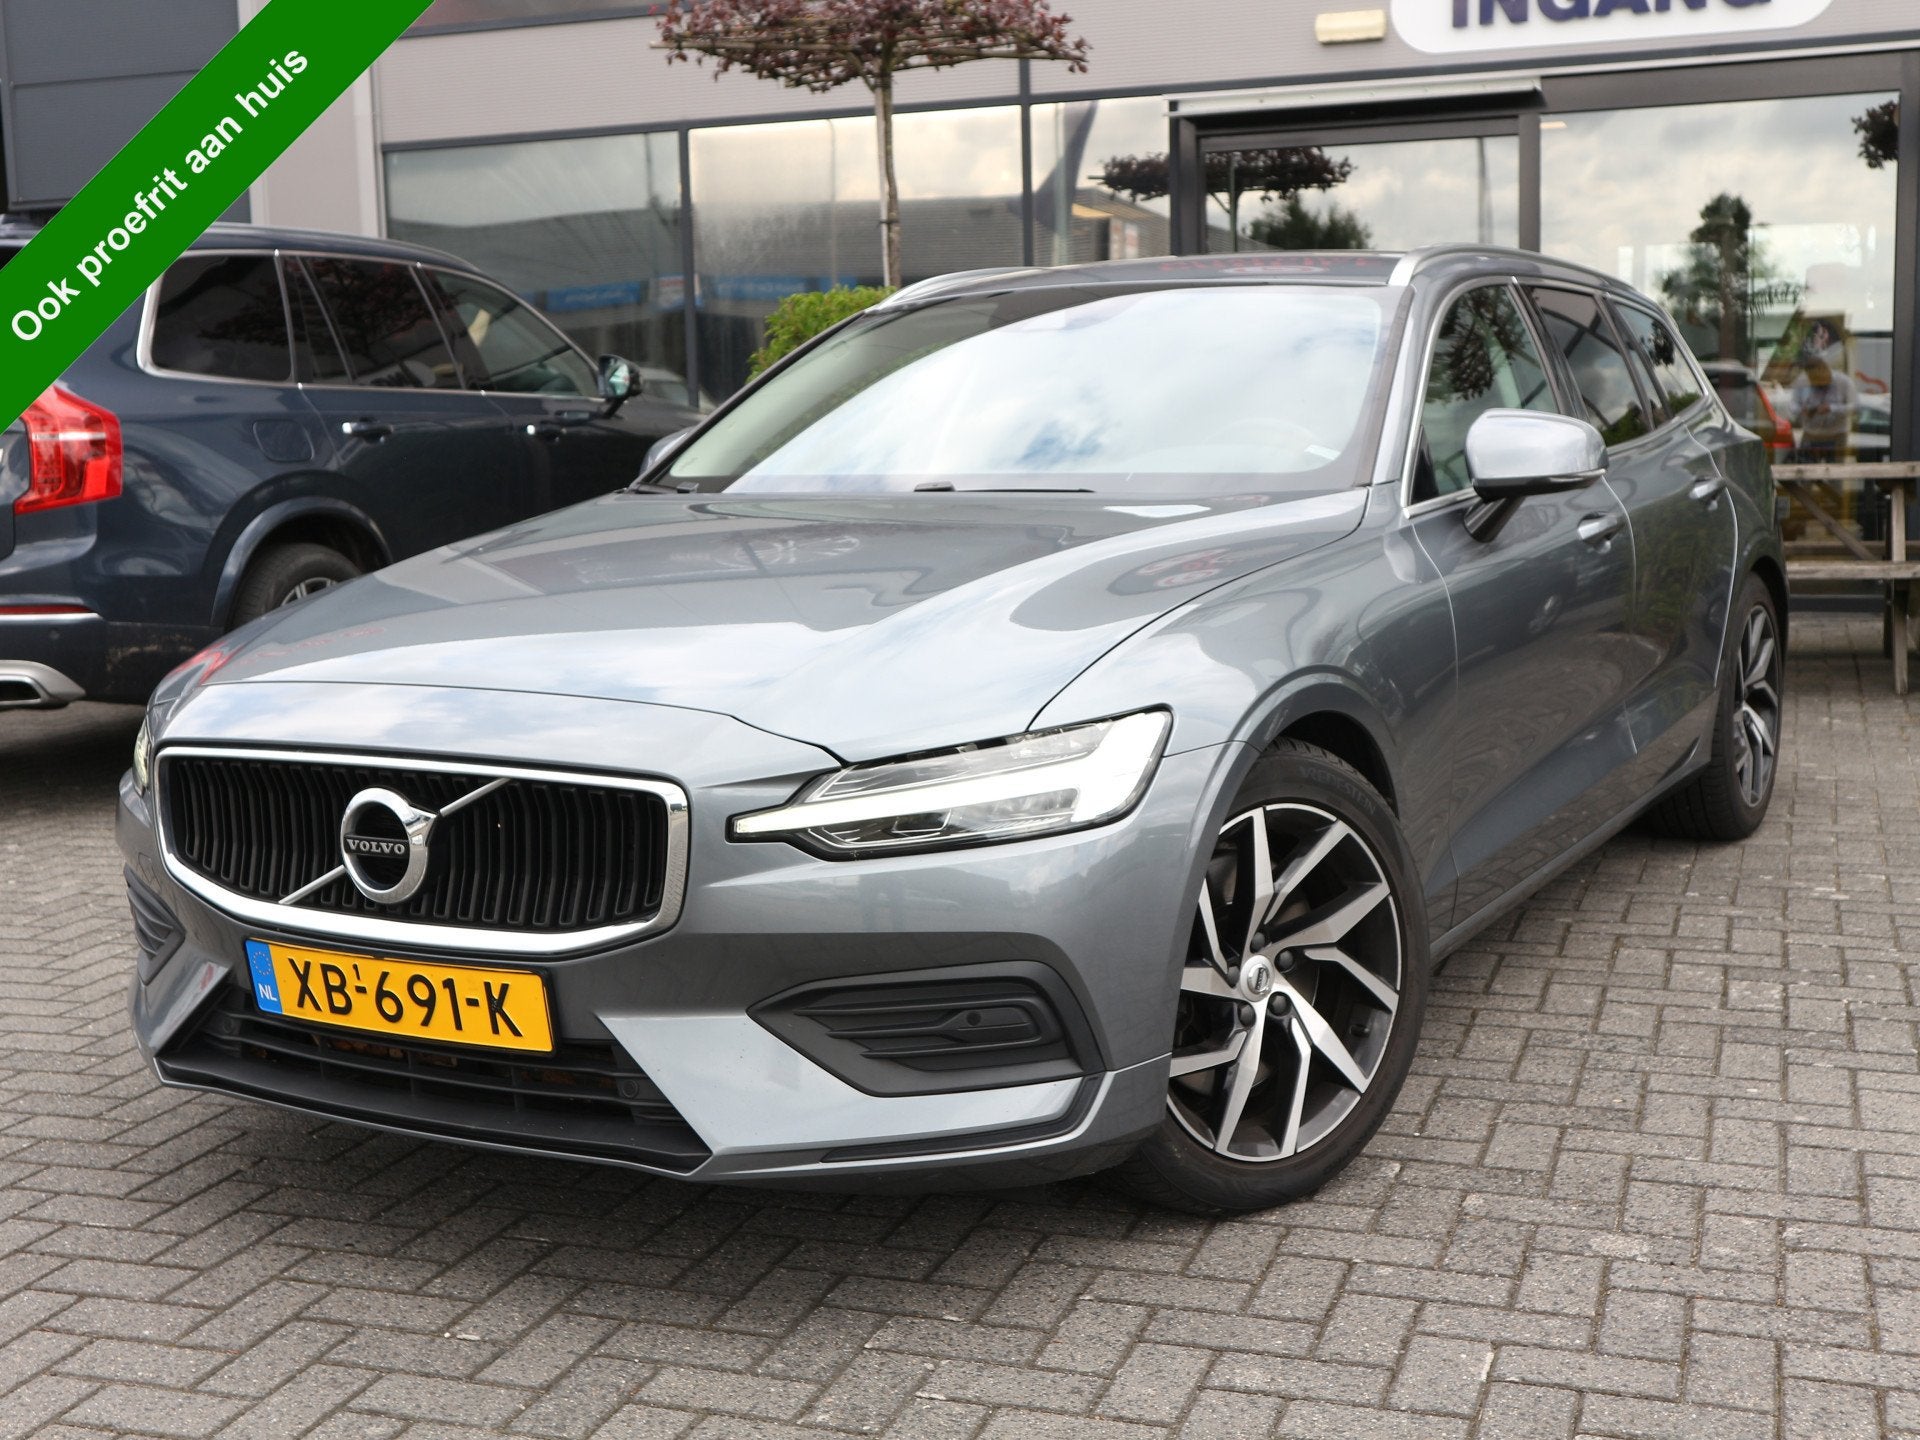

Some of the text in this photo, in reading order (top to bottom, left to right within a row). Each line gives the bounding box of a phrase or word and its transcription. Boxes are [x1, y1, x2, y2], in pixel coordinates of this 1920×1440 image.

[1452, 0, 1772, 28] ING
[346, 838, 405, 855] VOLVO
[258, 982, 278, 1002] NL
